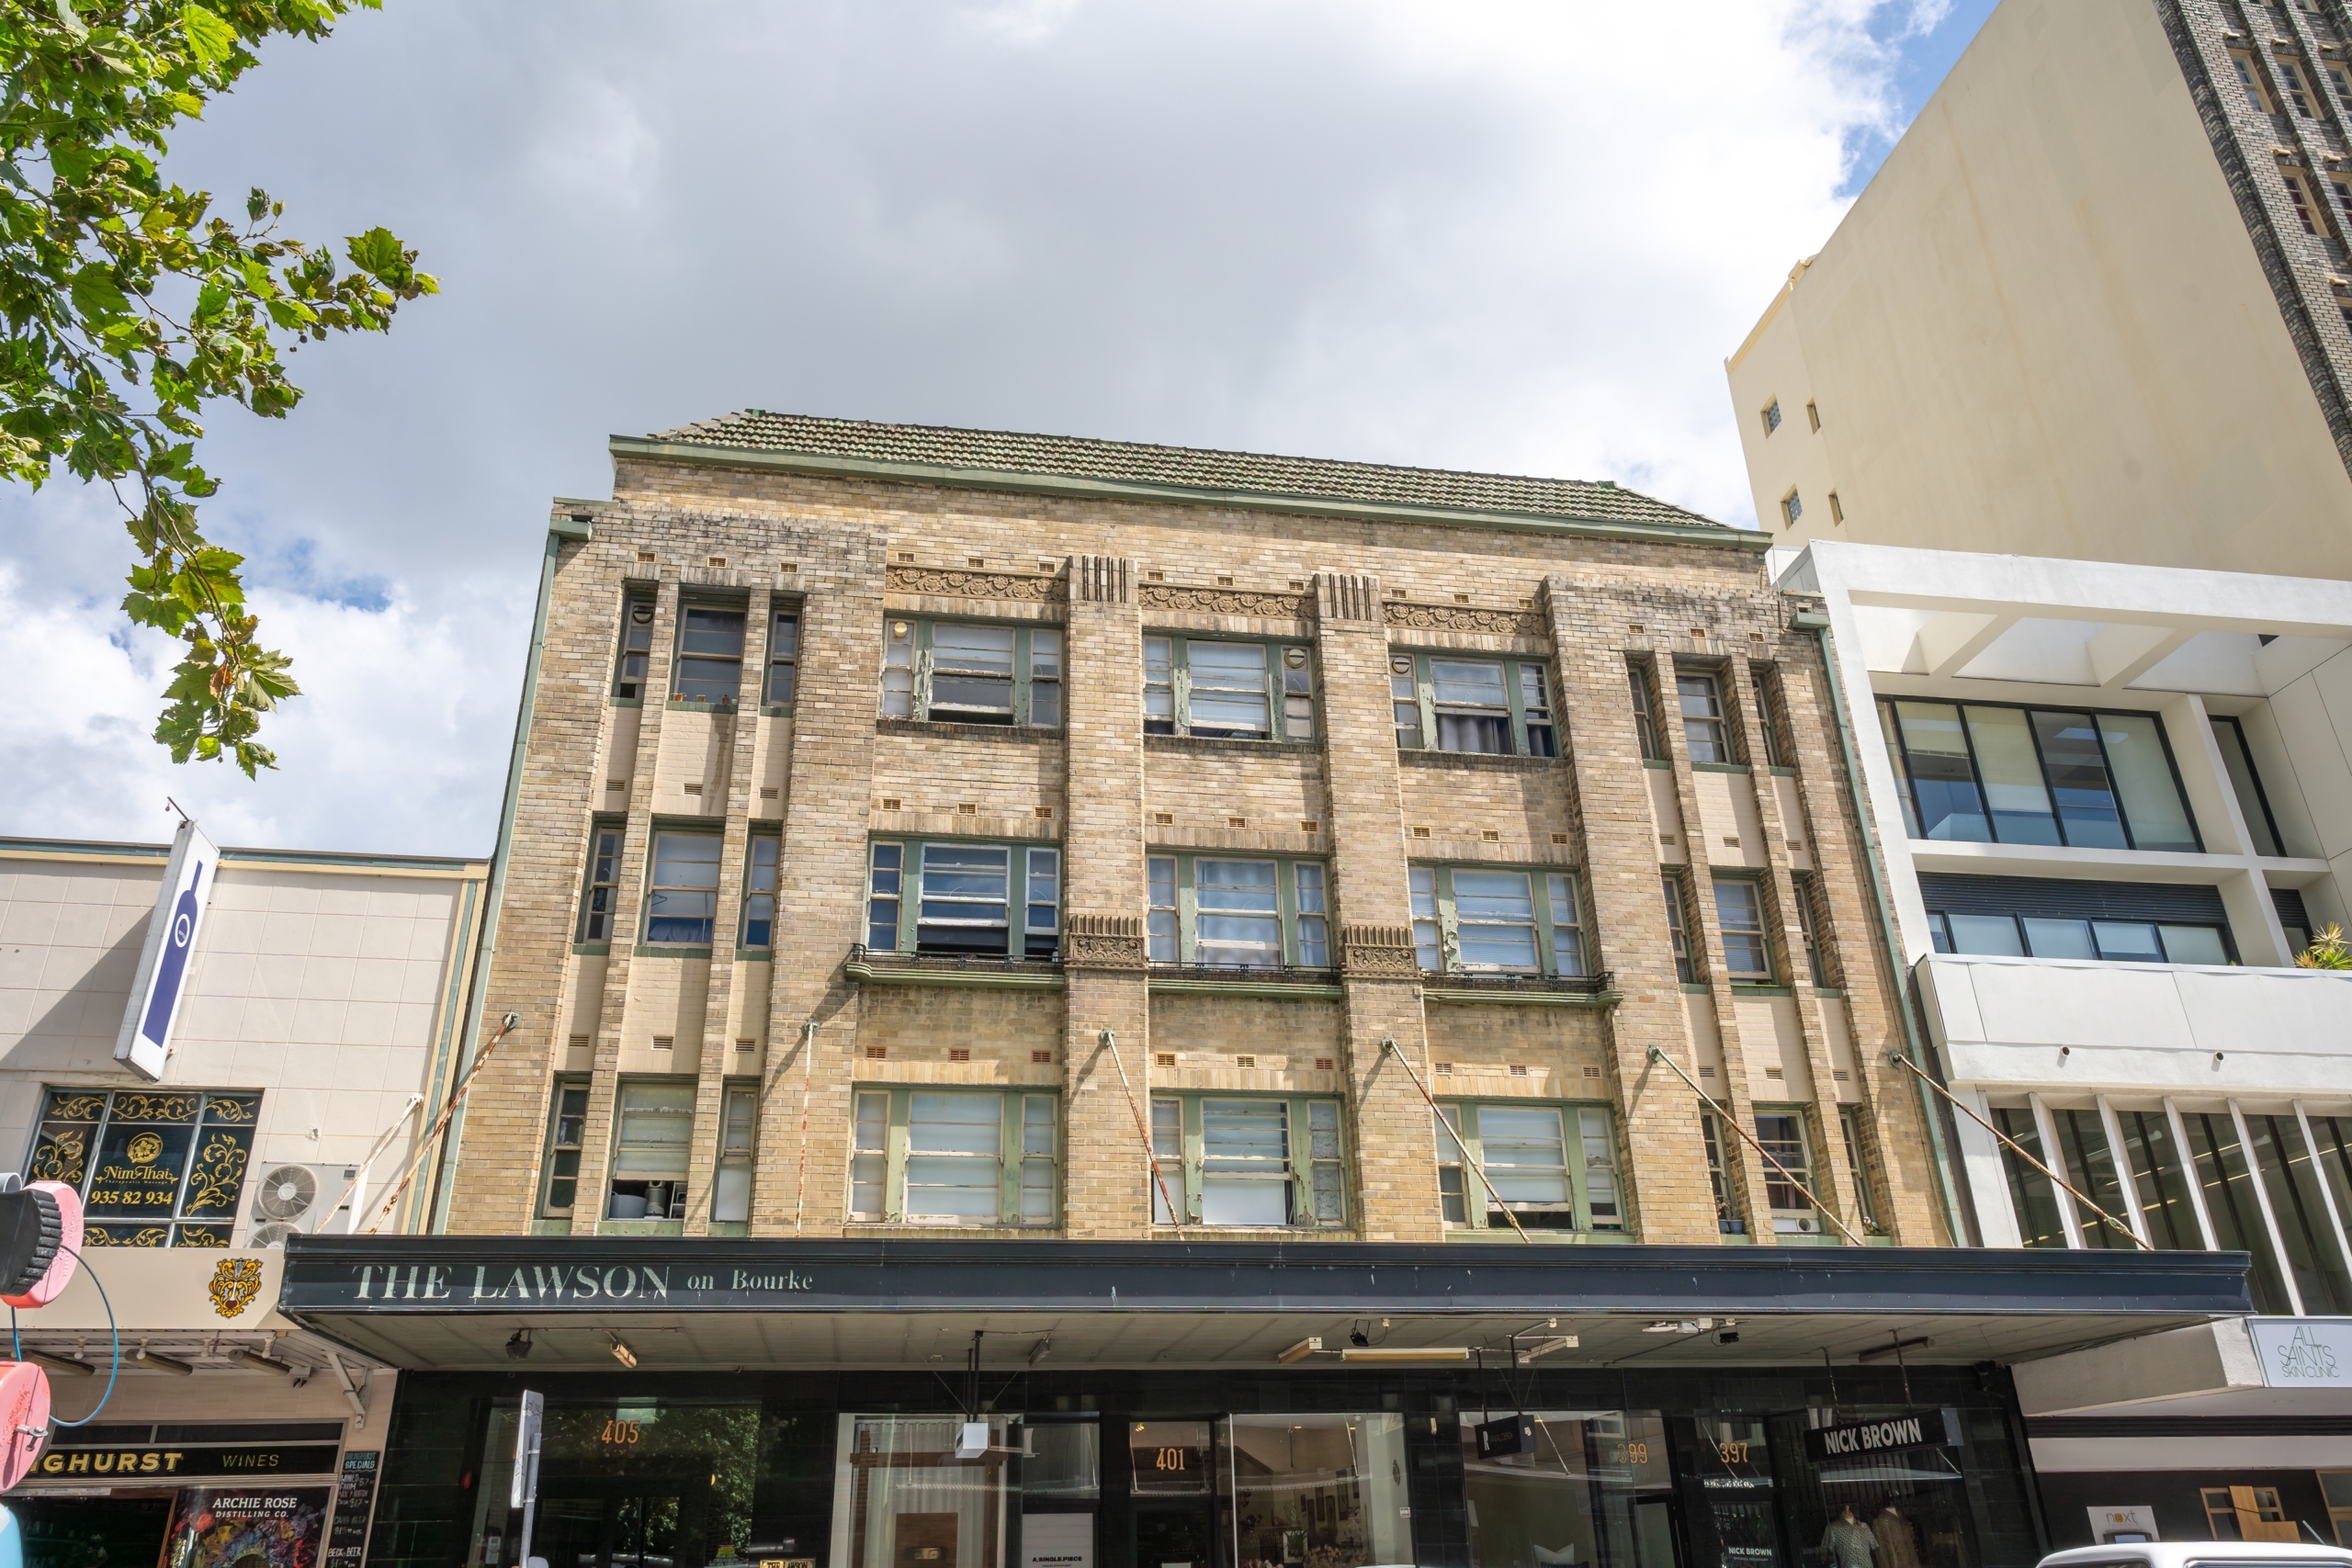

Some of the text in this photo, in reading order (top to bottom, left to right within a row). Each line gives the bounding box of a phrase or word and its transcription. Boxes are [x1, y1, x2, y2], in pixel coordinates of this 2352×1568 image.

[90, 1190, 174, 1205] 935 82 934
[351, 1265, 814, 1300] THE LAWSON on Bourke
[2291, 1325, 2323, 1347] ALL
[2277, 1345, 2336, 1367] SAINTS
[2281, 1365, 2340, 1378] SKIN CLINIC
[601, 1419, 640, 1444] 405
[1824, 1418, 1922, 1454] NICK BROWN
[1156, 1448, 1185, 1471] 401
[1617, 1443, 1648, 1464] 399
[1719, 1441, 1748, 1463] 397
[222, 1454, 279, 1467] WINES
[345, 1461, 376, 1470] SPECIALS
[212, 1497, 298, 1509] ARCHIE ROSE
[215, 1510, 289, 1518] DISTILLING CO.
[2106, 1509, 2138, 1524] next
[346, 1547, 362, 1557] BEER
[1728, 1547, 1772, 1557] NICK BROWN
